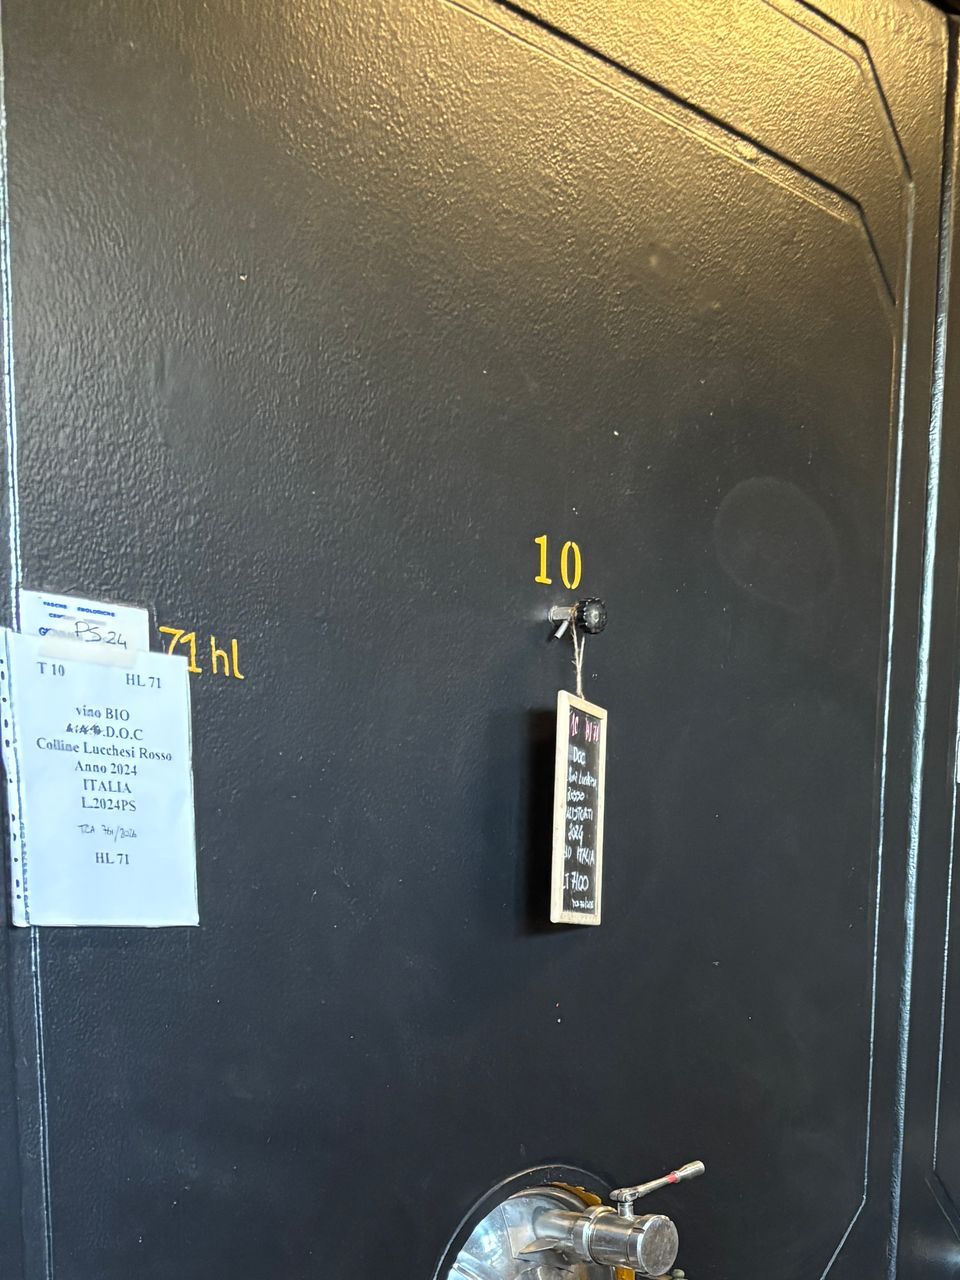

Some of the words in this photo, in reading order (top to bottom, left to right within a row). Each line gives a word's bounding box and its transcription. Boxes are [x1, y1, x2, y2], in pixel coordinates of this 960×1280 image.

[533, 534, 583, 590] 10
[159, 626, 203, 673] 71
[210, 634, 245, 679] hl
[37, 661, 47, 674] T
[52, 664, 65, 677] 10
[126, 673, 146, 687] HL
[148, 676, 161, 689] 71
[76, 704, 101, 719] vino
[105, 707, 130, 722] BIO
[36, 736, 80, 753] Colline
[83, 741, 135, 758] Lucchesi
[139, 747, 172, 761] Rosso
[74, 760, 107, 774] Anno
[110, 762, 138, 776] 2024
[83, 778, 132, 794] ITALIA
[95, 852, 115, 864] HL
[117, 853, 130, 865] 71
